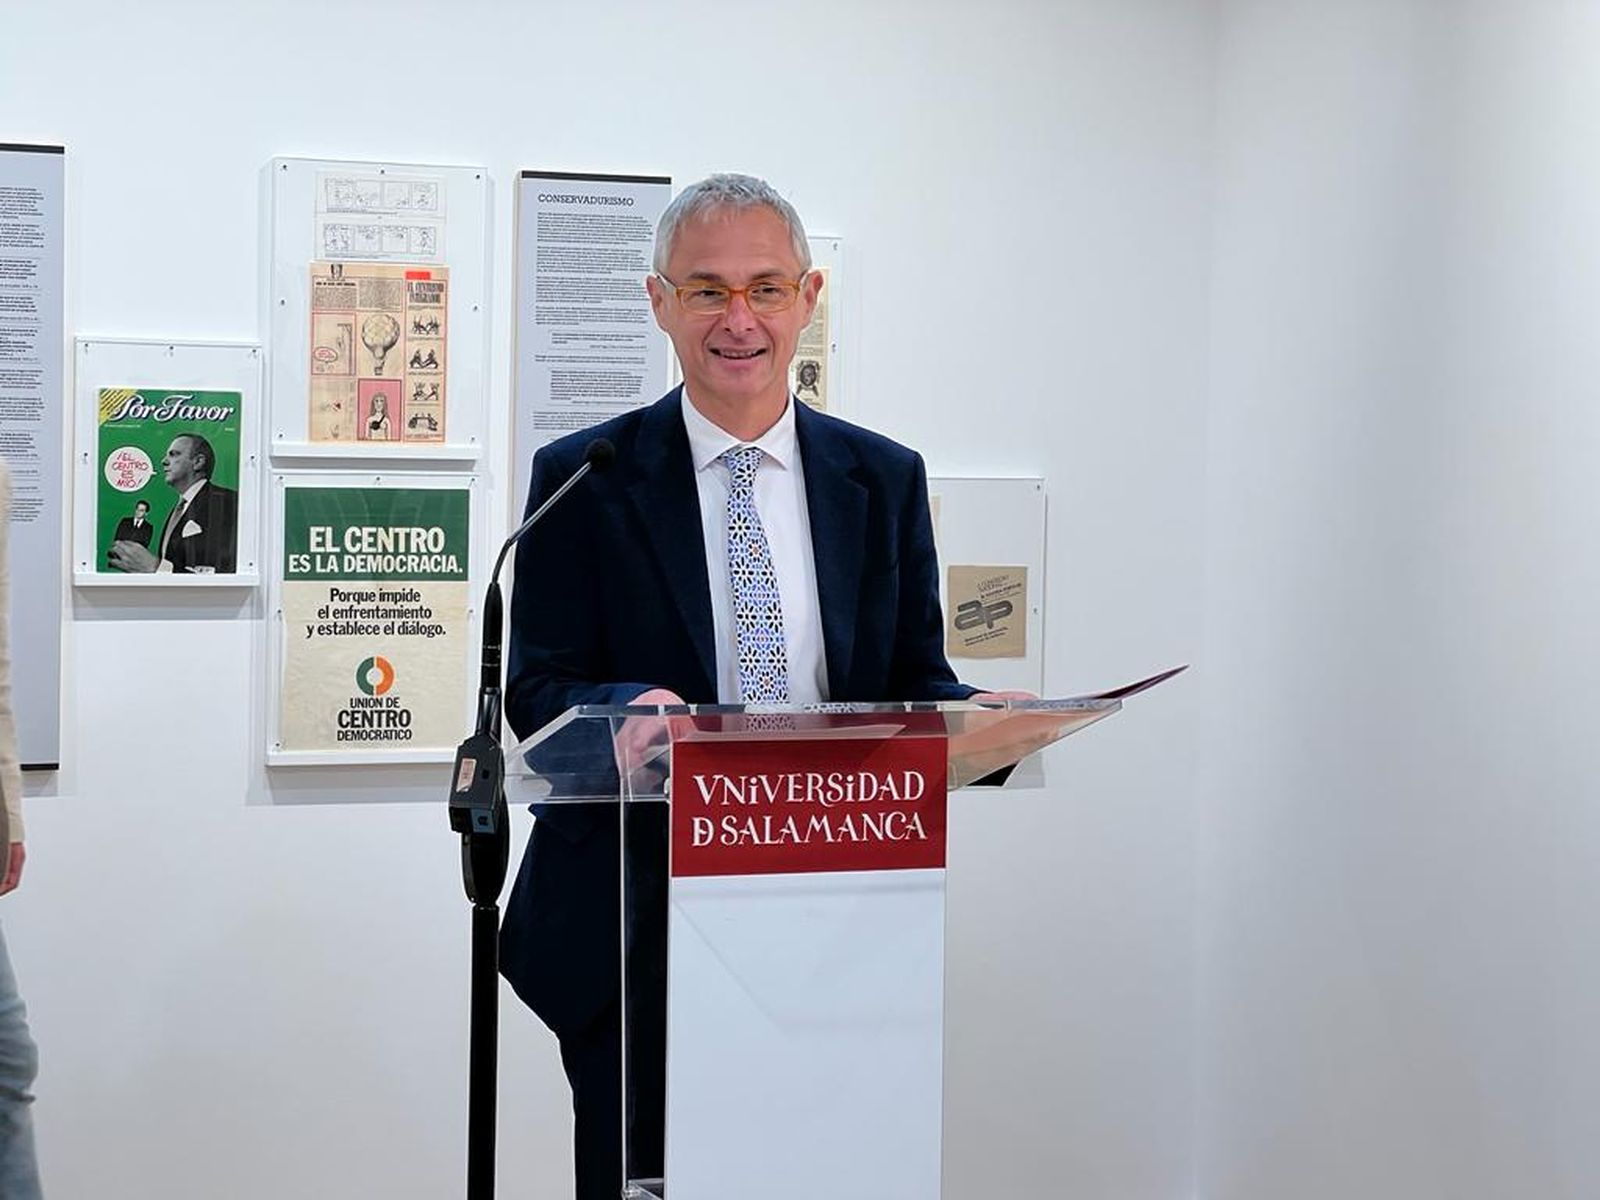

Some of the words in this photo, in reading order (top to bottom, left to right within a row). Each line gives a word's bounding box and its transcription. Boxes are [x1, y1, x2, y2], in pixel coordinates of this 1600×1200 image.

[538, 193, 634, 207] CONSERVADURISMO
[110, 395, 155, 421] Por
[154, 394, 235, 423] Favor
[112, 462, 149, 471] CENTRO
[121, 471, 134, 479] ES
[309, 526, 341, 553] EL
[344, 526, 446, 553] CENTRO
[288, 554, 311, 573] ES
[315, 555, 339, 573] LA
[343, 554, 463, 573] DEMOCRACIA.
[330, 588, 376, 605] Porque
[378, 588, 421, 605] impide
[317, 606, 329, 619] el
[332, 606, 432, 620] enfrentamiento
[306, 624, 315, 639] y
[317, 621, 380, 636] establece
[383, 621, 395, 636] el
[397, 620, 446, 638] diálogo.
[350, 697, 383, 709] UNION
[386, 697, 400, 709] DE
[337, 709, 412, 729] CENTRO
[337, 729, 412, 741] DEMOCRATICO
[720, 811, 927, 846] SALAMANCA
